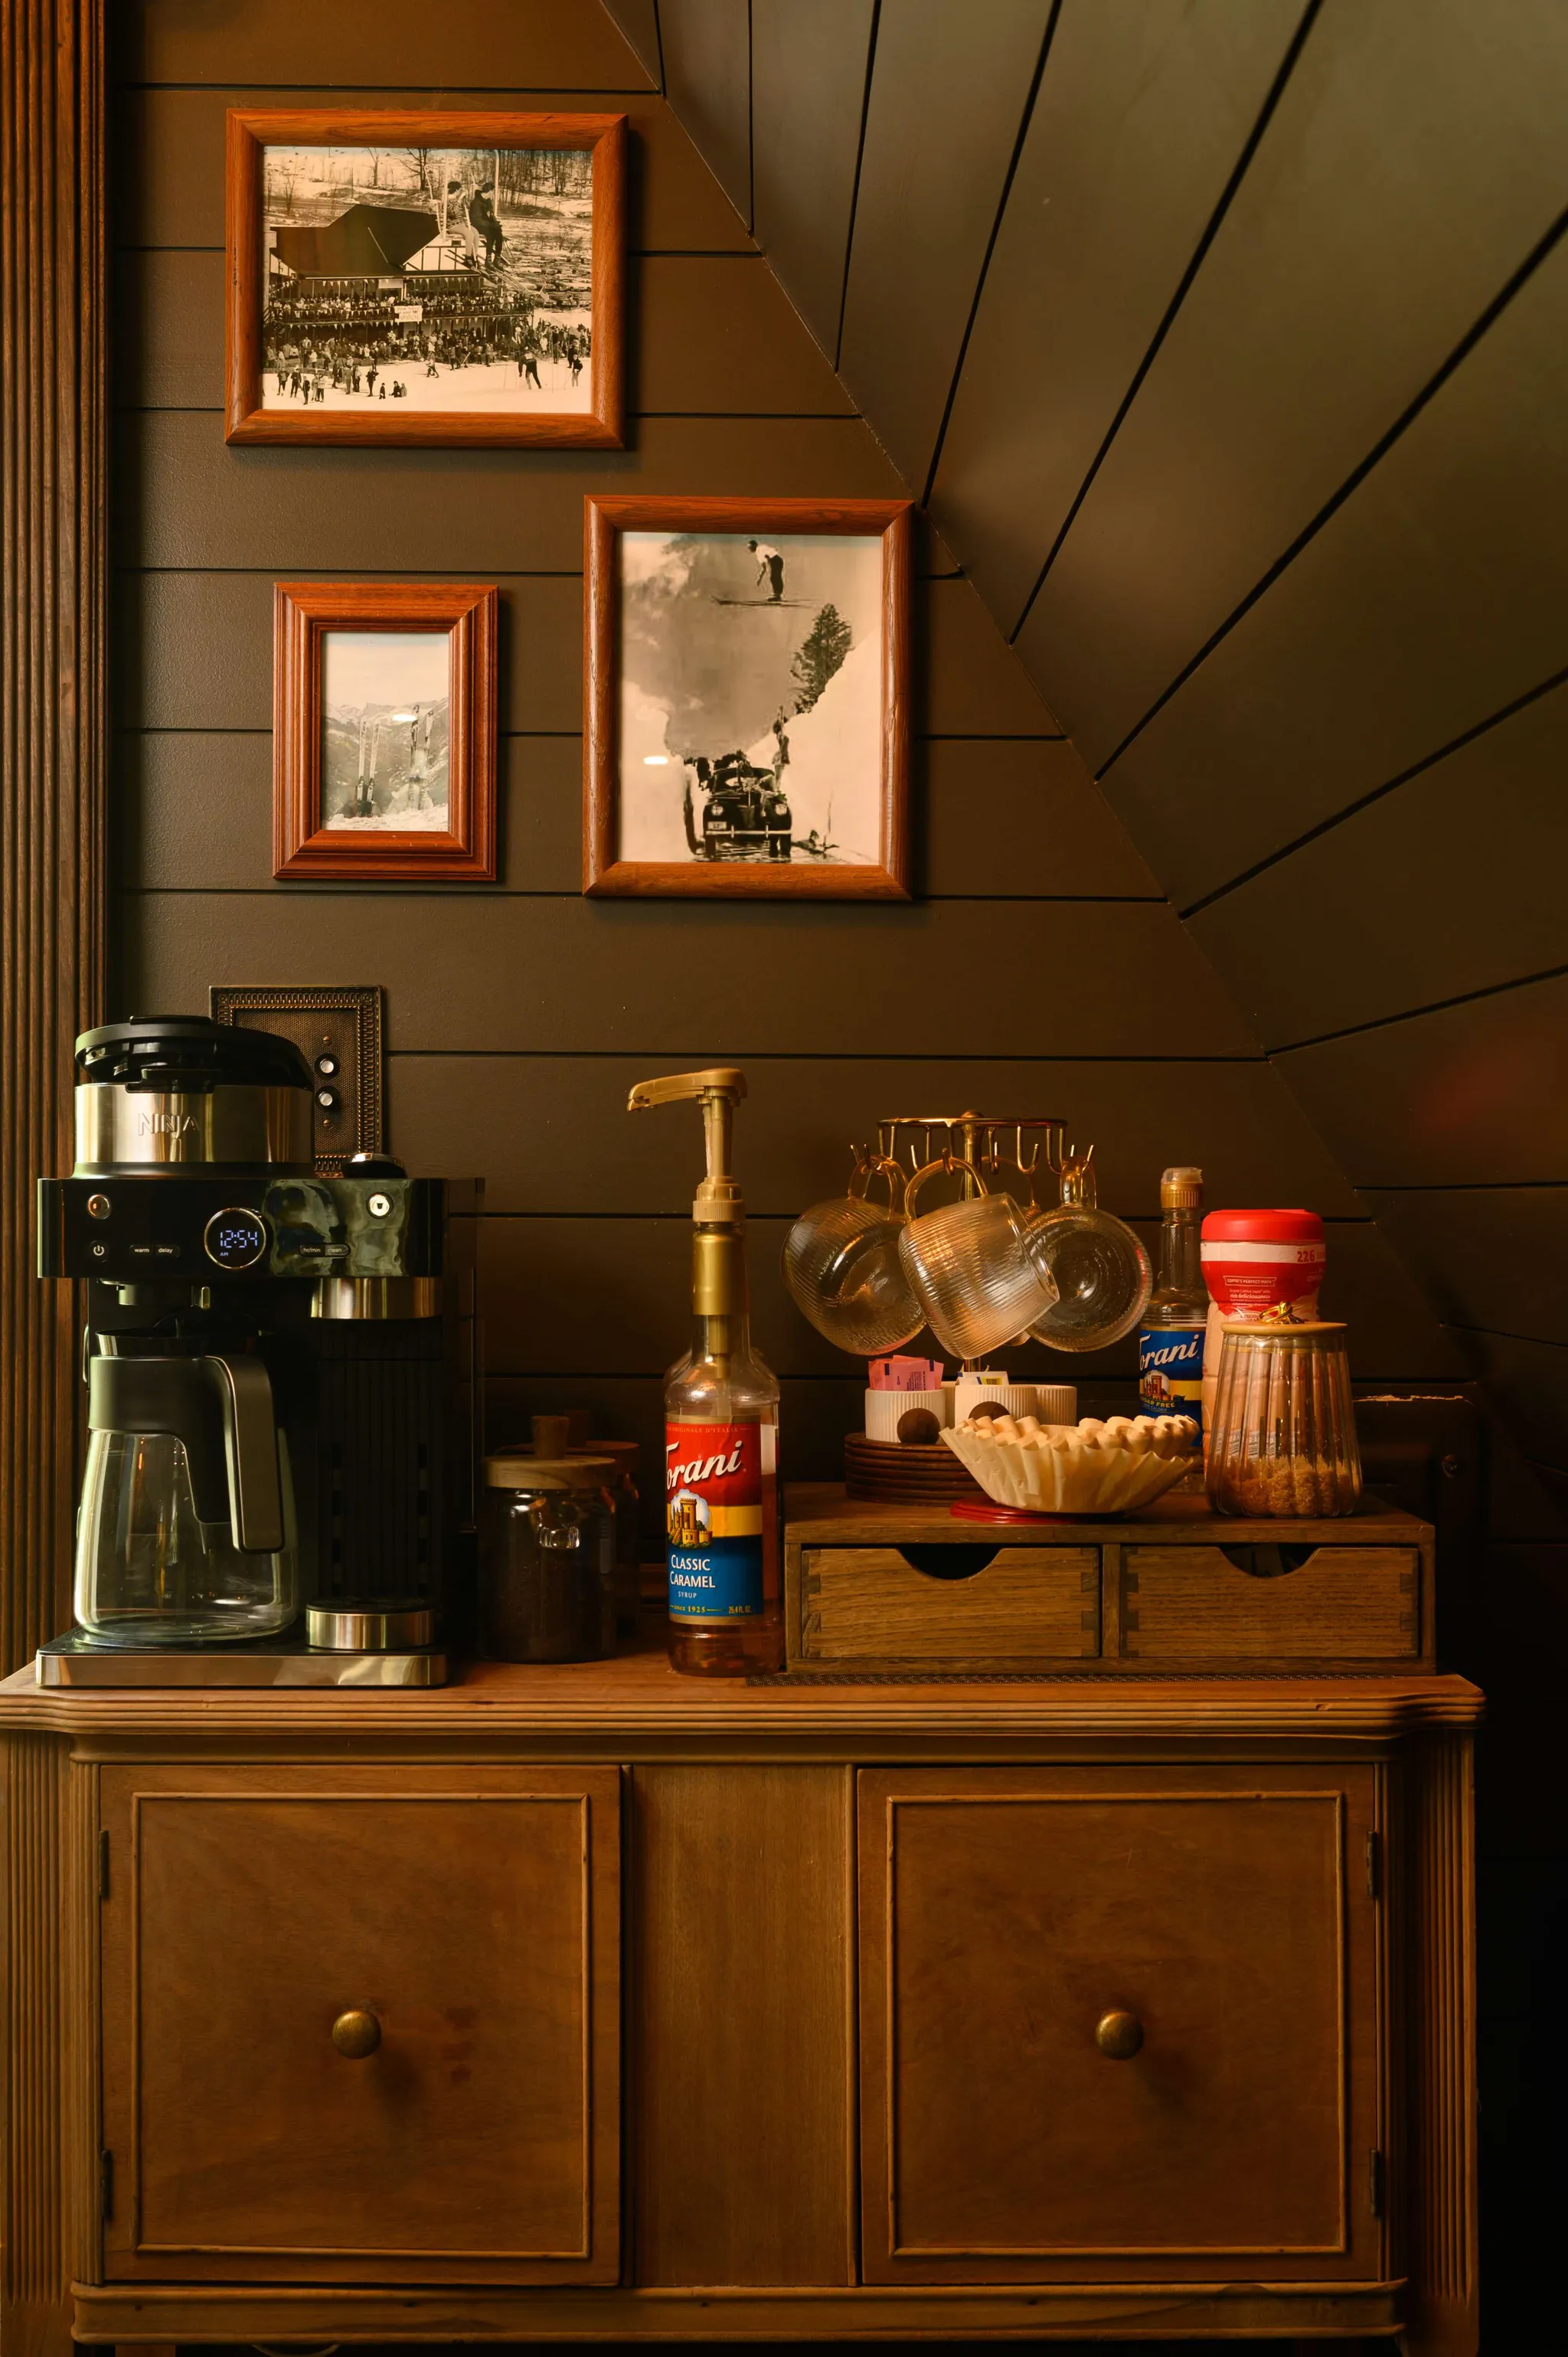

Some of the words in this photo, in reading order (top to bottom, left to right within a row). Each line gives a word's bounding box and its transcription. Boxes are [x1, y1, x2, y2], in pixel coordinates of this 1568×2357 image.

[138, 1113, 199, 1139] NINJA
[220, 1230, 258, 1248] 12:54
[1297, 1250, 1315, 1263] 226
[671, 1554, 710, 1571] CLASSIC
[670, 1571, 716, 1587] CARAMEL
